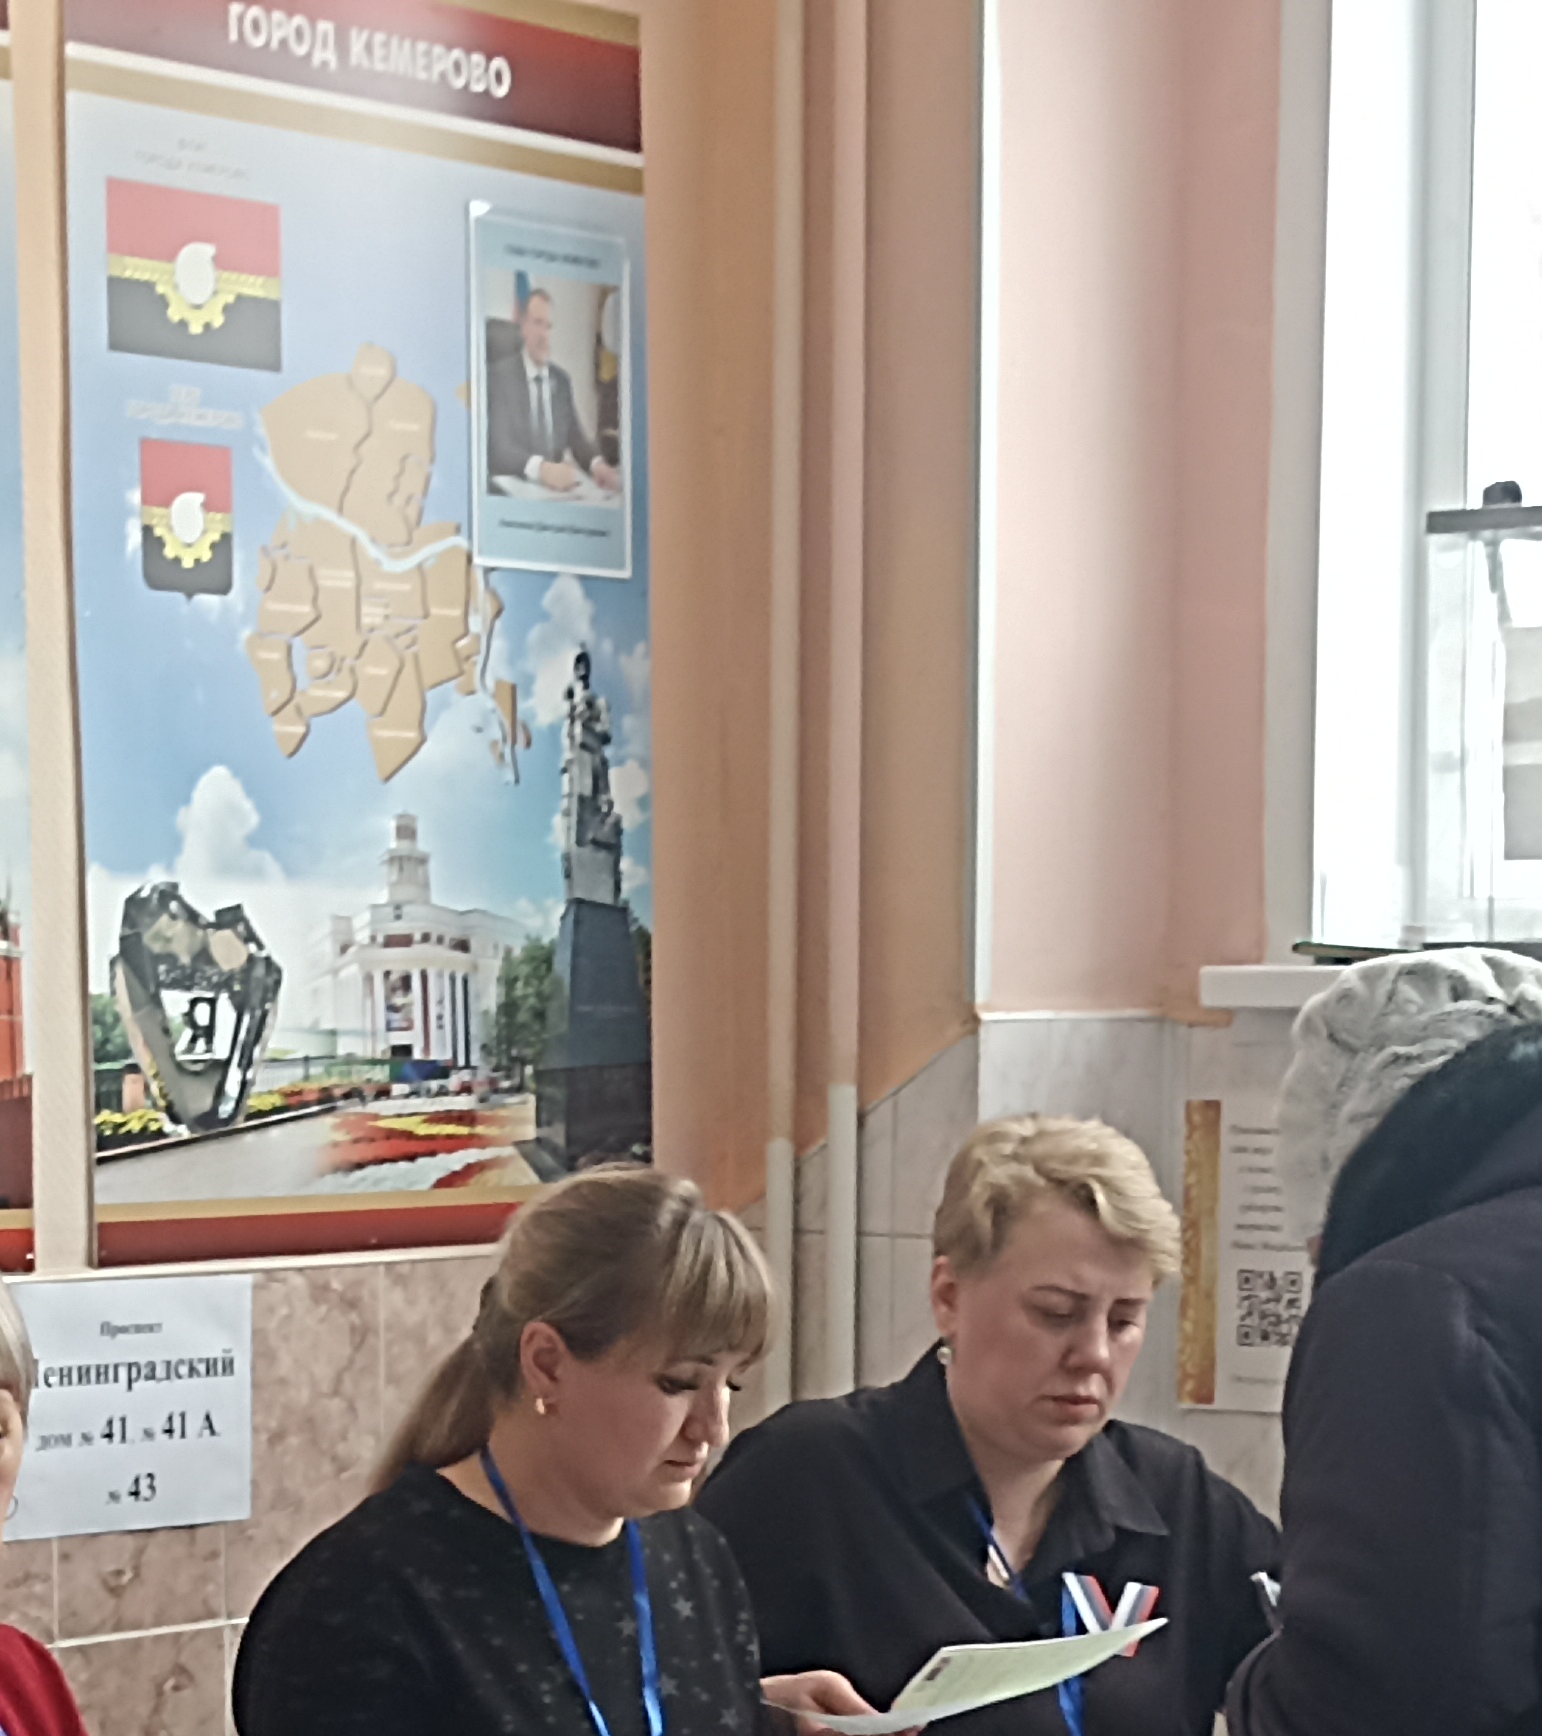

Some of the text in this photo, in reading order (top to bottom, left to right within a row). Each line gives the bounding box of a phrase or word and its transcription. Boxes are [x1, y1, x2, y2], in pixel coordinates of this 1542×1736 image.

[228, 1, 512, 99] ГОРОД КЕМЕРОВО
[161, 1411, 187, 1440] 41
[127, 1472, 157, 1502] 43
